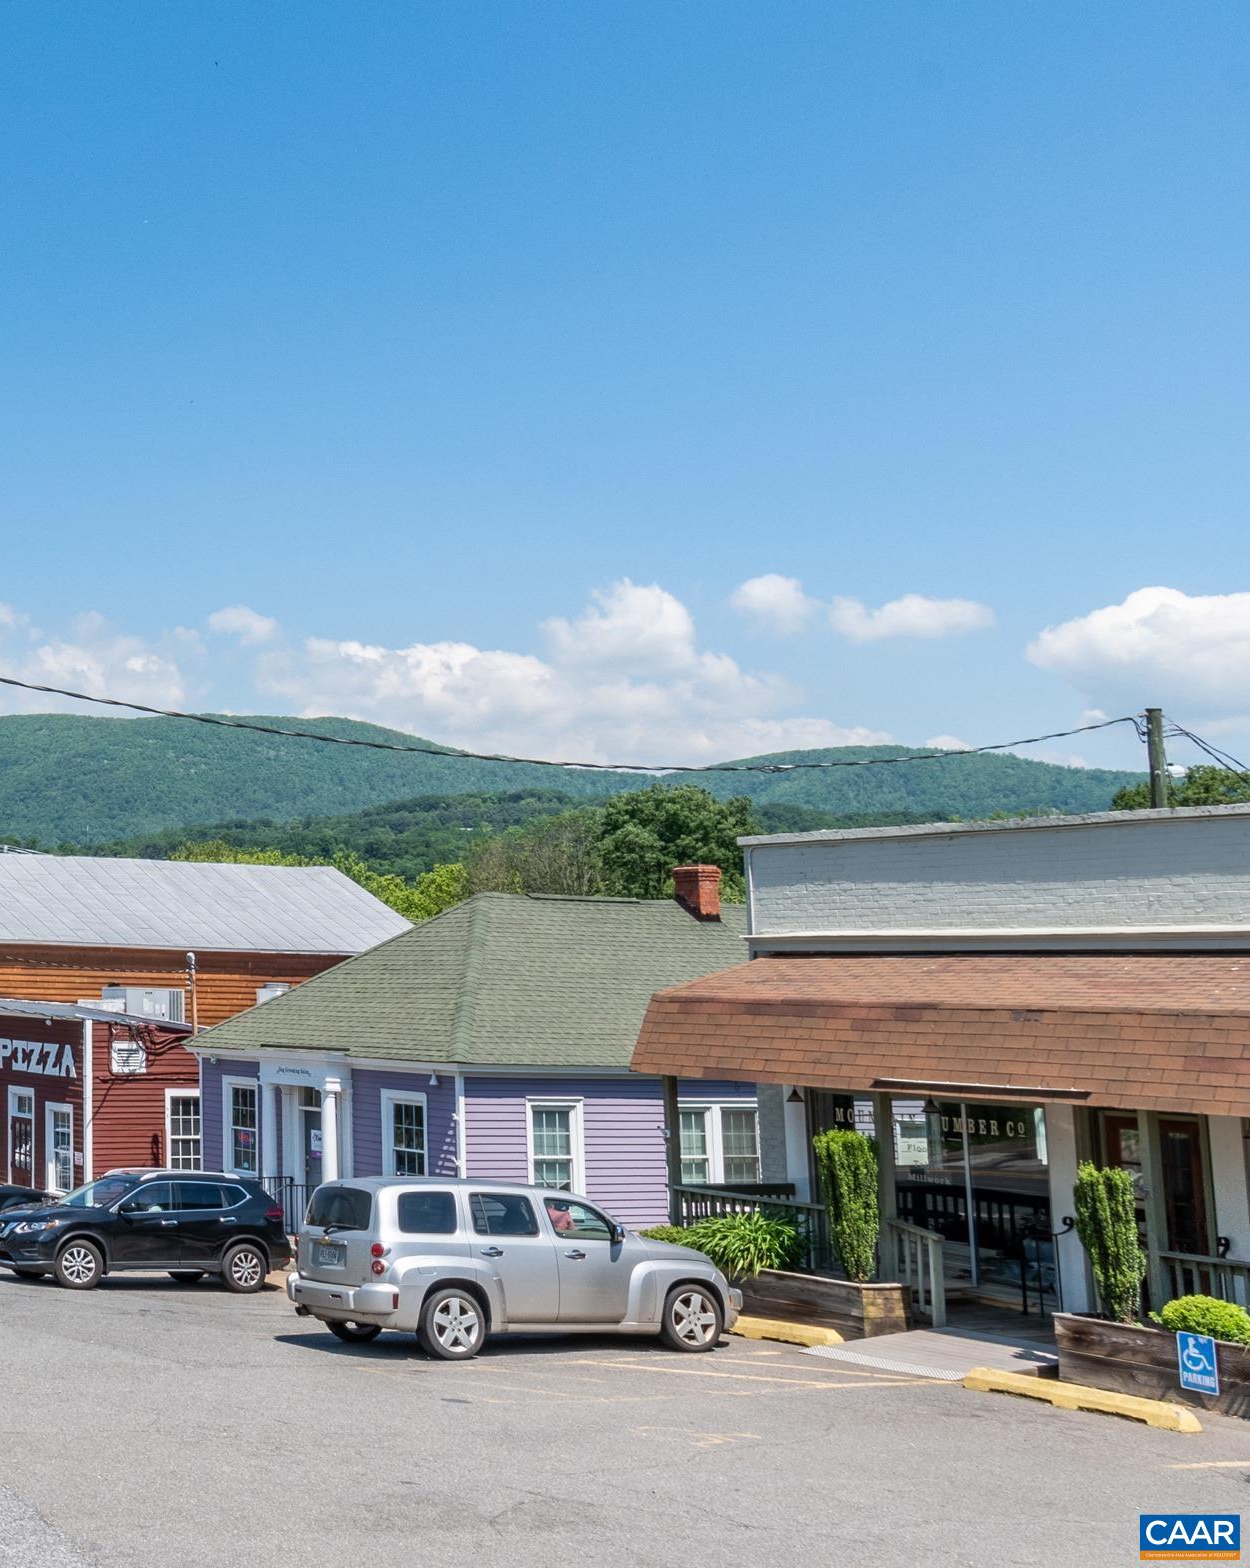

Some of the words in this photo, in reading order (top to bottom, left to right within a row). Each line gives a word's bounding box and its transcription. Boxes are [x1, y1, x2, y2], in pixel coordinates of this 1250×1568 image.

[941, 1116, 999, 1136] UMBER
[908, 1172, 951, 1185] Millwork
[1183, 1371, 1216, 1388] PARKING
